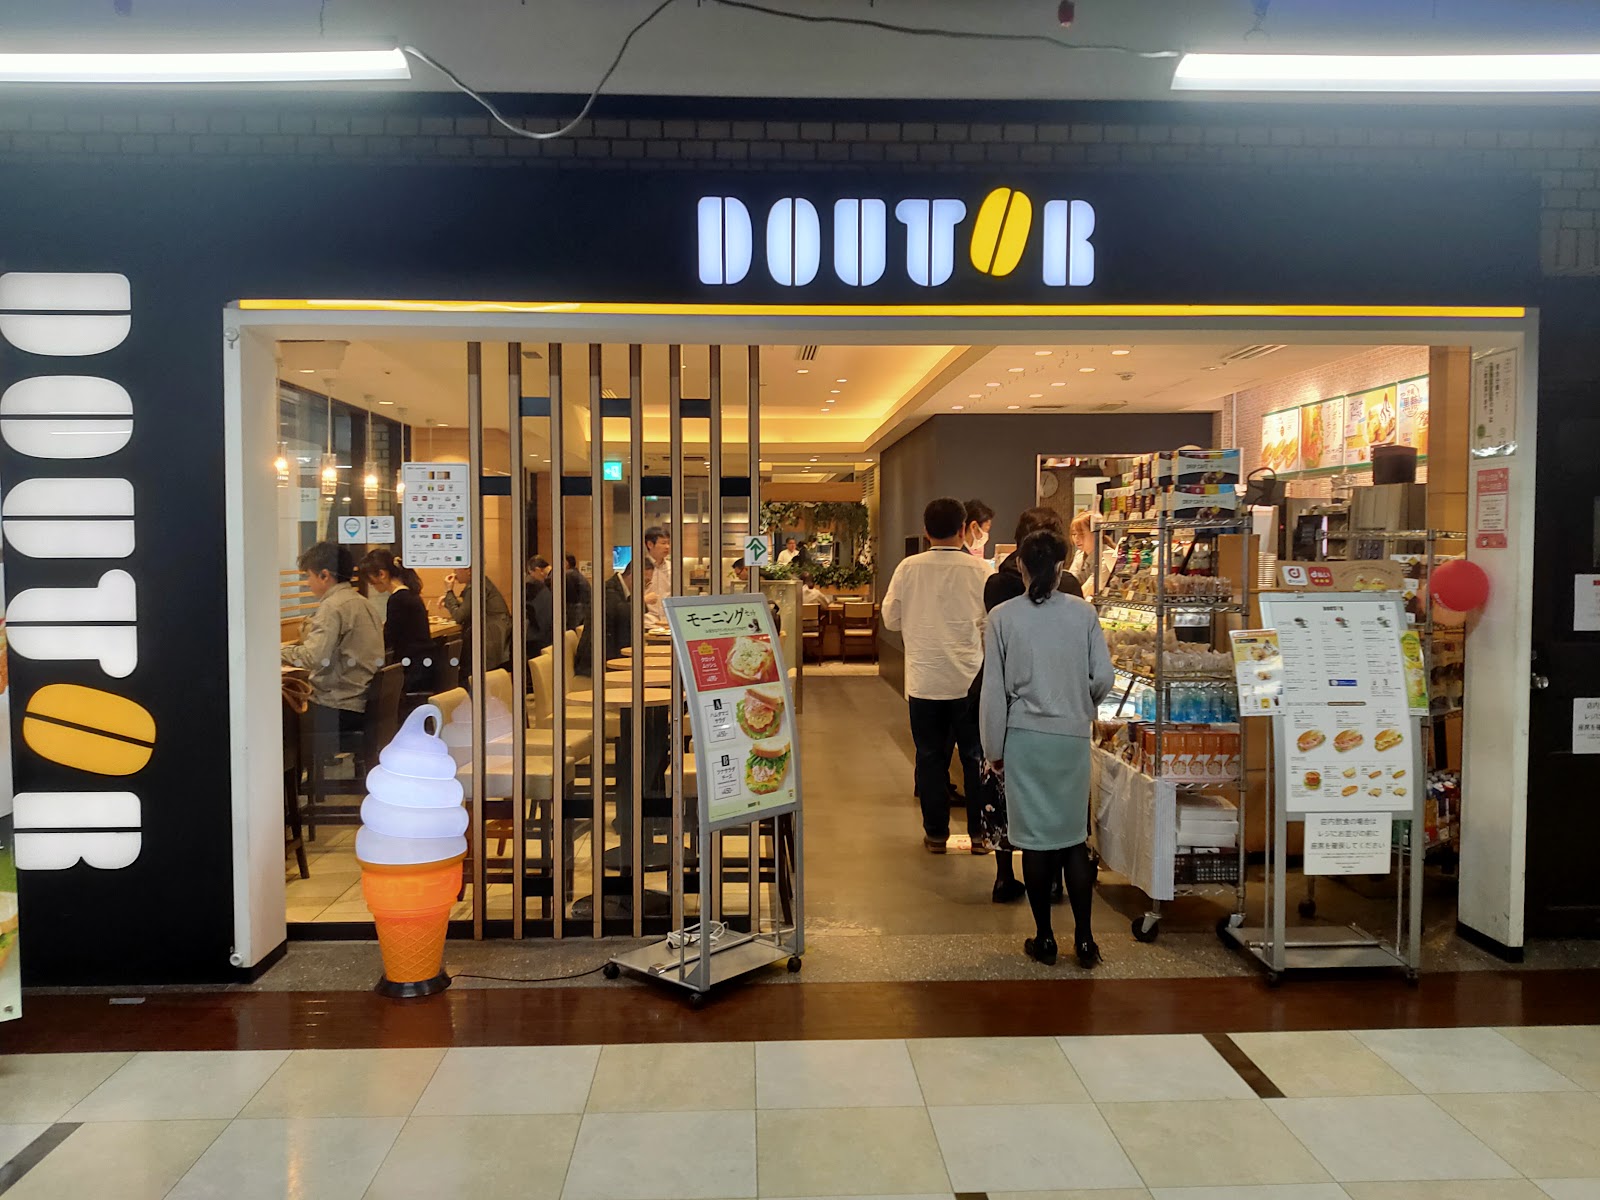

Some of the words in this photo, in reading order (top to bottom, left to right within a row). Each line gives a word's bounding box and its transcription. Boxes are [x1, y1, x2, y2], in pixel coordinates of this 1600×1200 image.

[698, 187, 1095, 287] DOUTOR
[0, 272, 156, 870] DOUTOR
[1310, 842, 1386, 850] 座席を確保してください
[1320, 818, 1377, 826] 店内飲食の場合は
